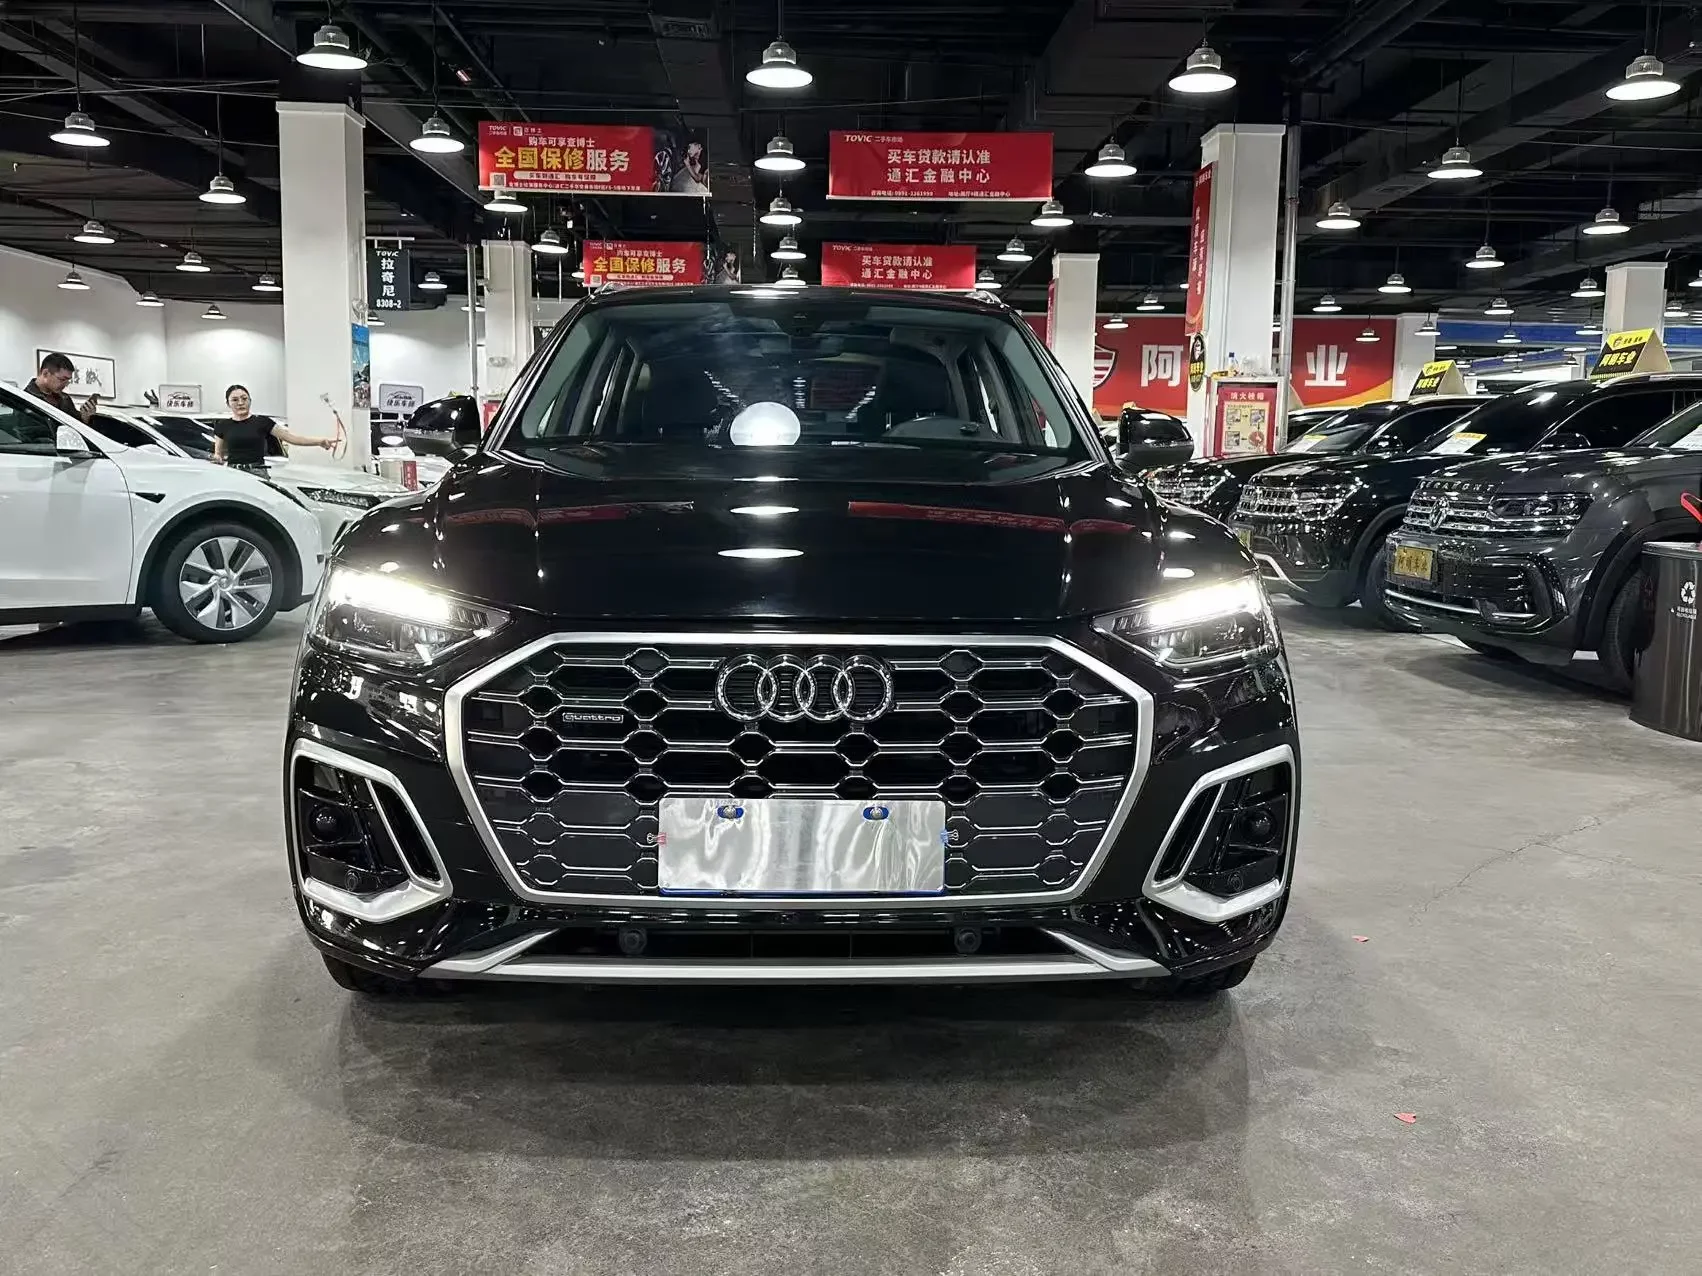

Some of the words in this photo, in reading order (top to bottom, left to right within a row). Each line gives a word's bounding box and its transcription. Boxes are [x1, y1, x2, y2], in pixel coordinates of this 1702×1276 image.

[528, 136, 595, 148] 购车可享查博士
[845, 134, 872, 143] TOVIC
[494, 146, 630, 172] 全国保修服务
[887, 149, 991, 165] 买车贷款请认准
[887, 168, 990, 184] 通汇金融中心
[593, 256, 686, 273] 全国保修服务
[862, 255, 933, 267] 买车贷款请认准
[381, 257, 396, 297] 拉奇尼
[861, 268, 933, 279] 通汇金融中心
[376, 298, 402, 309] 8308-2
[564, 714, 621, 722] quattro
